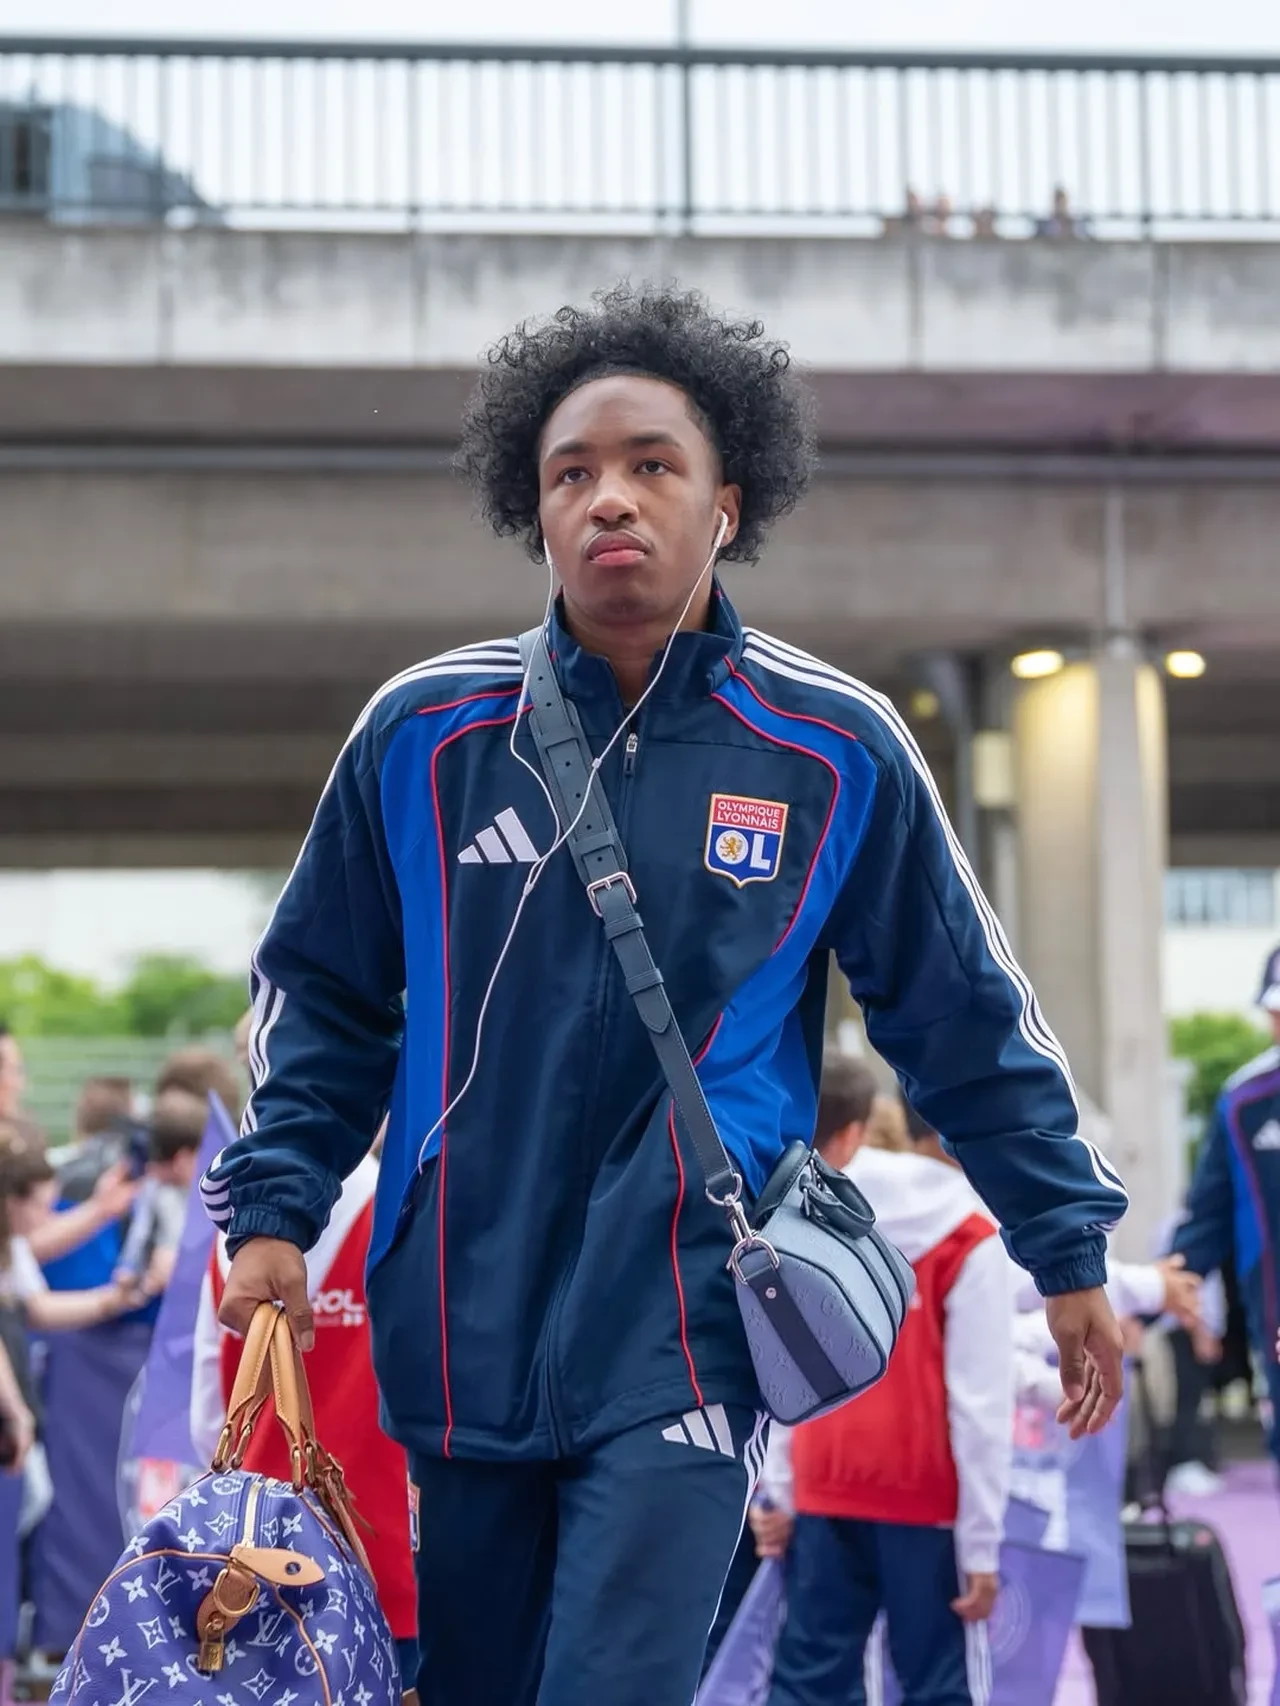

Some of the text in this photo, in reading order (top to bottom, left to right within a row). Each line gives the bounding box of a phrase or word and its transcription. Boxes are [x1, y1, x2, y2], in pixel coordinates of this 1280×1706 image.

[718, 801, 780, 819] OLYMPIQUE
[717, 811, 778, 829] LYONNAIS
[715, 829, 771, 871] OL
